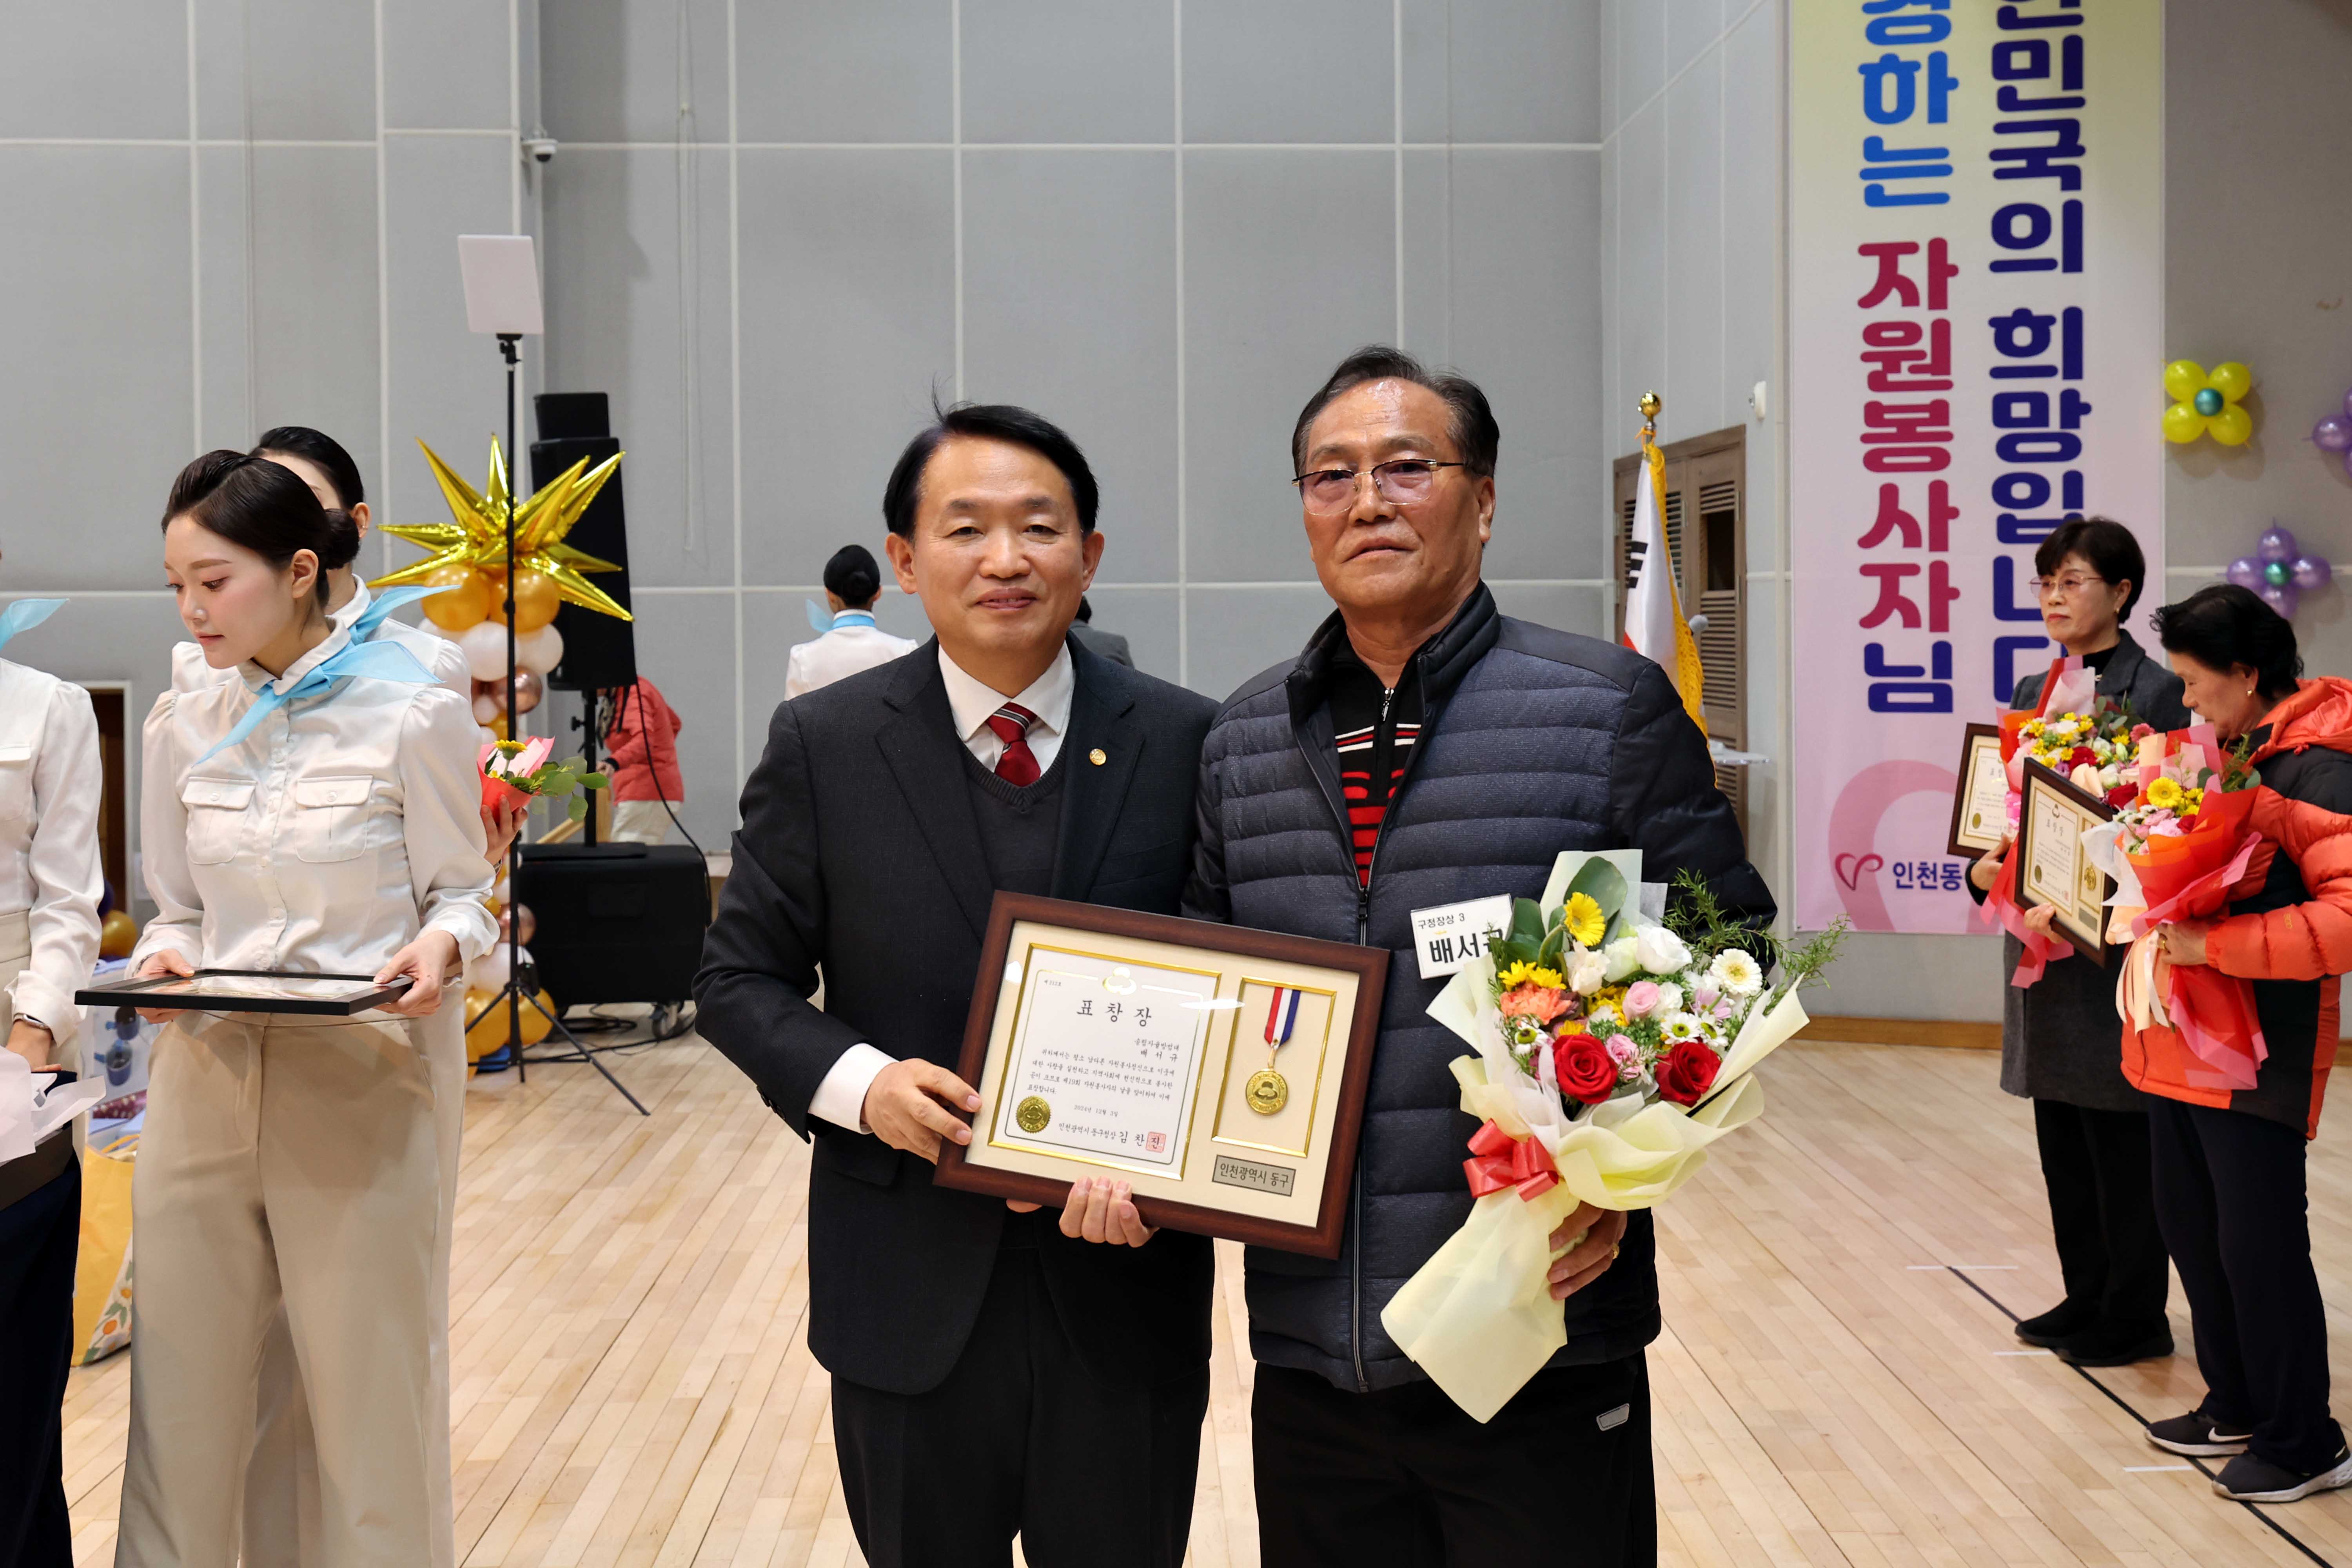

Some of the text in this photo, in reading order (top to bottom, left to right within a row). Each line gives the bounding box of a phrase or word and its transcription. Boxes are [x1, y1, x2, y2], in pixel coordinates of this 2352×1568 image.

[1858, 237, 1960, 713] 자원봉사자님
[1417, 913, 1465, 929] 구청장상 3
[1220, 1162, 1289, 1188] 인천광역시 동구
